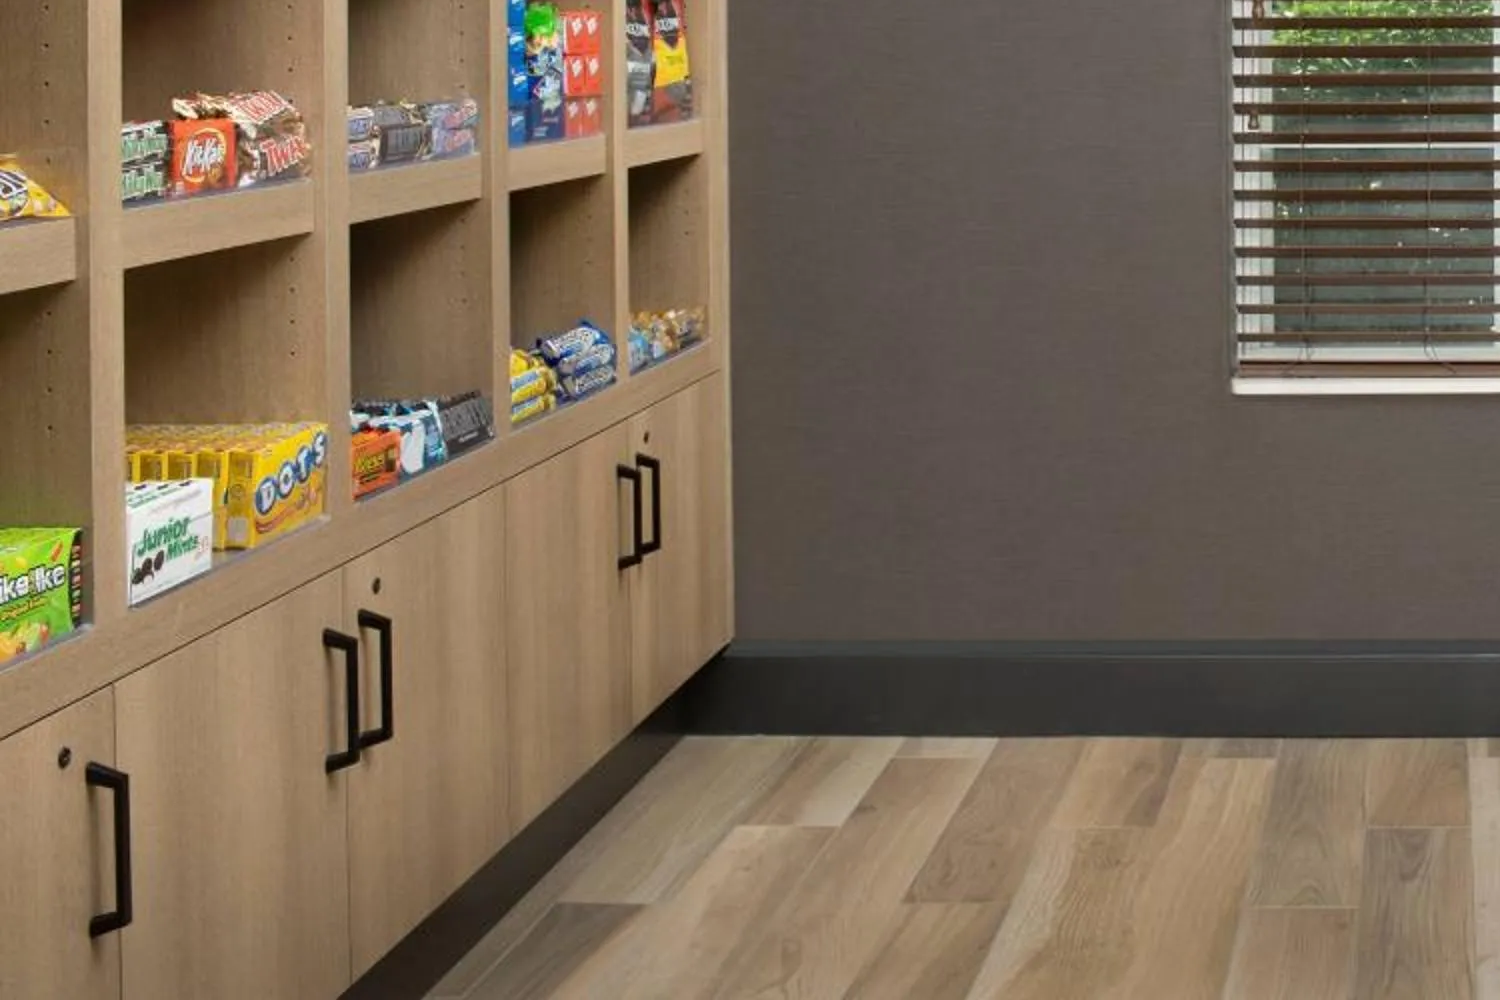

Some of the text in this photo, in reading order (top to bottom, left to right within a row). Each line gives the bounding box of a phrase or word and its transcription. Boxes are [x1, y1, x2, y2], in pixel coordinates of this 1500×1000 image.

[255, 431, 328, 515] DOTS
[137, 517, 191, 557] Junior
[166, 535, 199, 561] Mints
